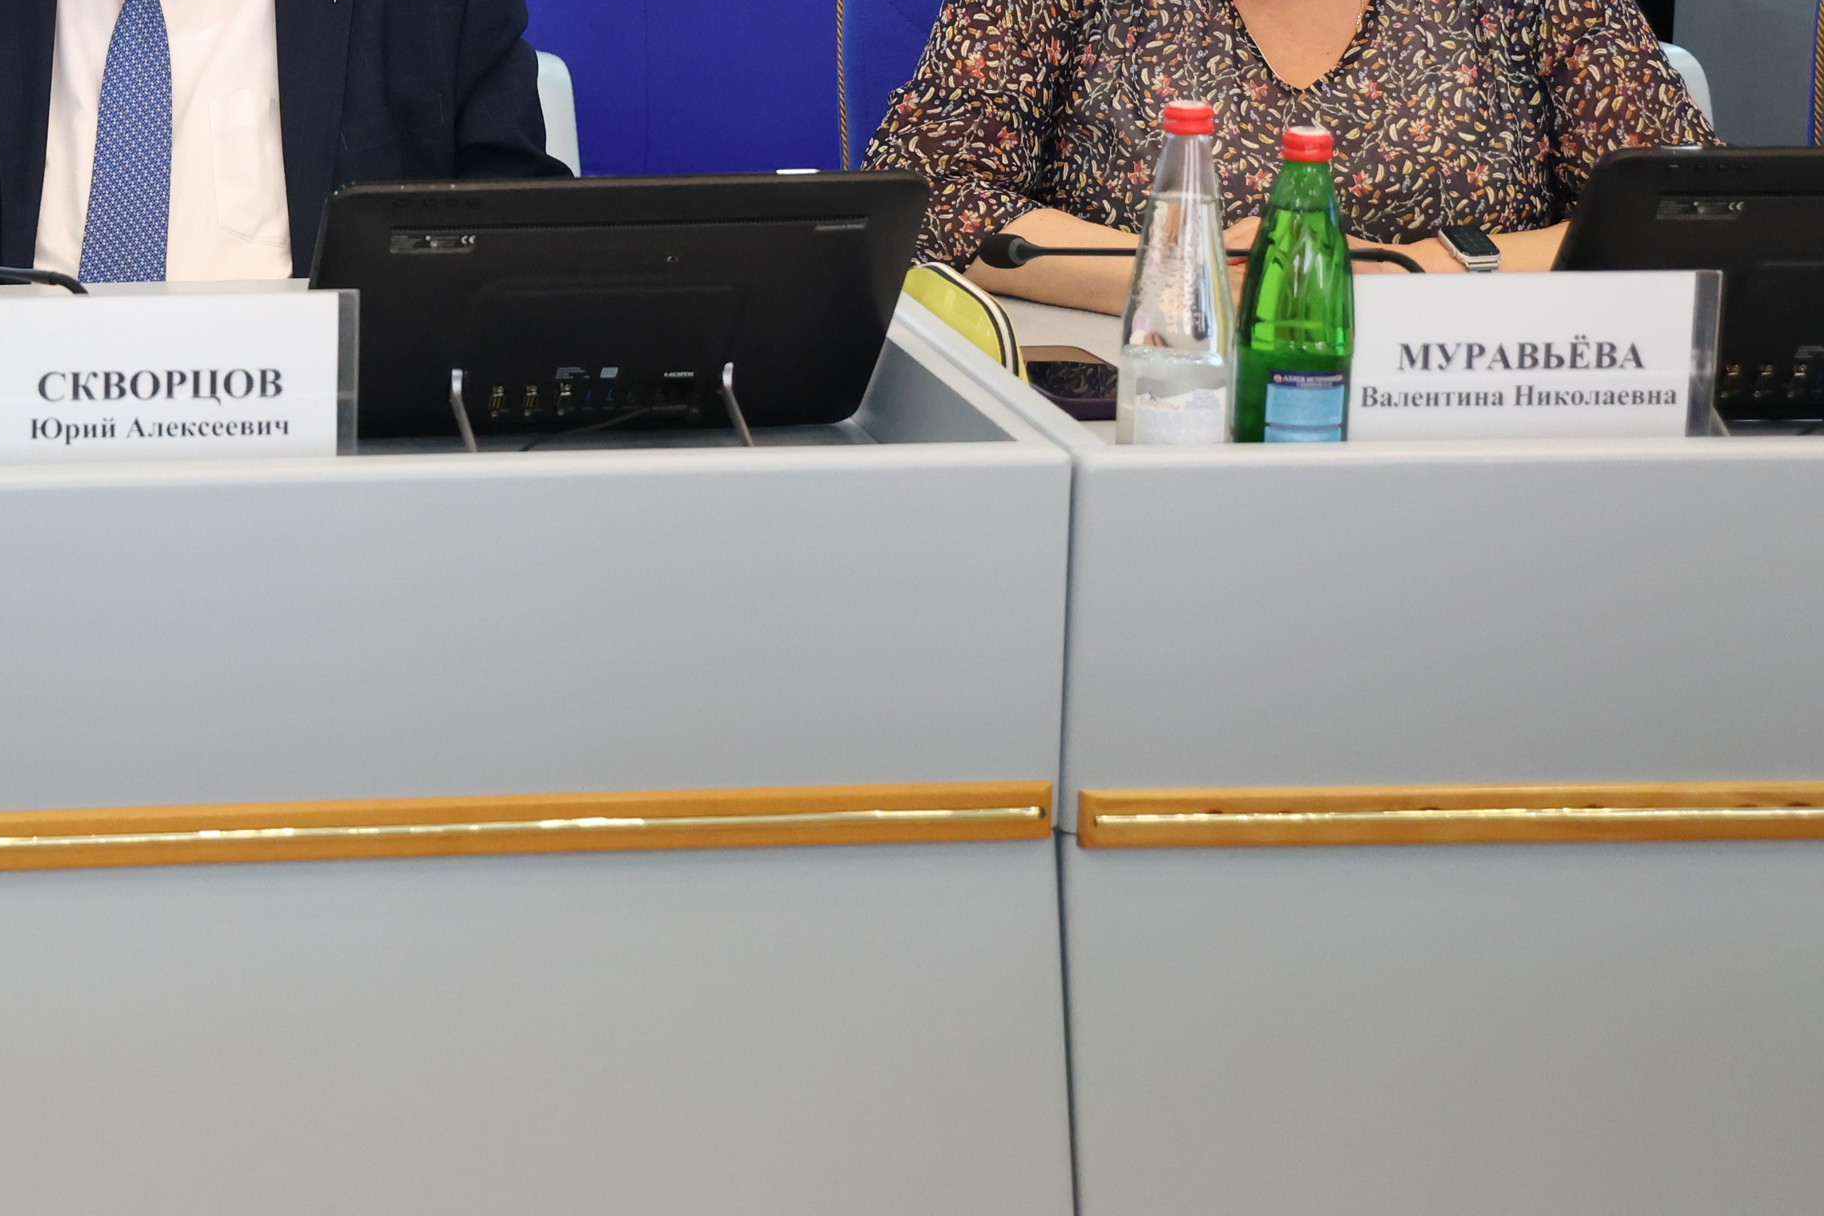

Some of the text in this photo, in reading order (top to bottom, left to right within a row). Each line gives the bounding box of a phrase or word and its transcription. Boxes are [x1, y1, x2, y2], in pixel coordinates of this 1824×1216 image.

[1398, 332, 1646, 372] МУРАВЬЁВА
[37, 368, 284, 404] СКВОРЦОВ
[1361, 384, 1677, 408] Валентина Николаевна
[30, 416, 290, 446] Юрий Алексеевич
